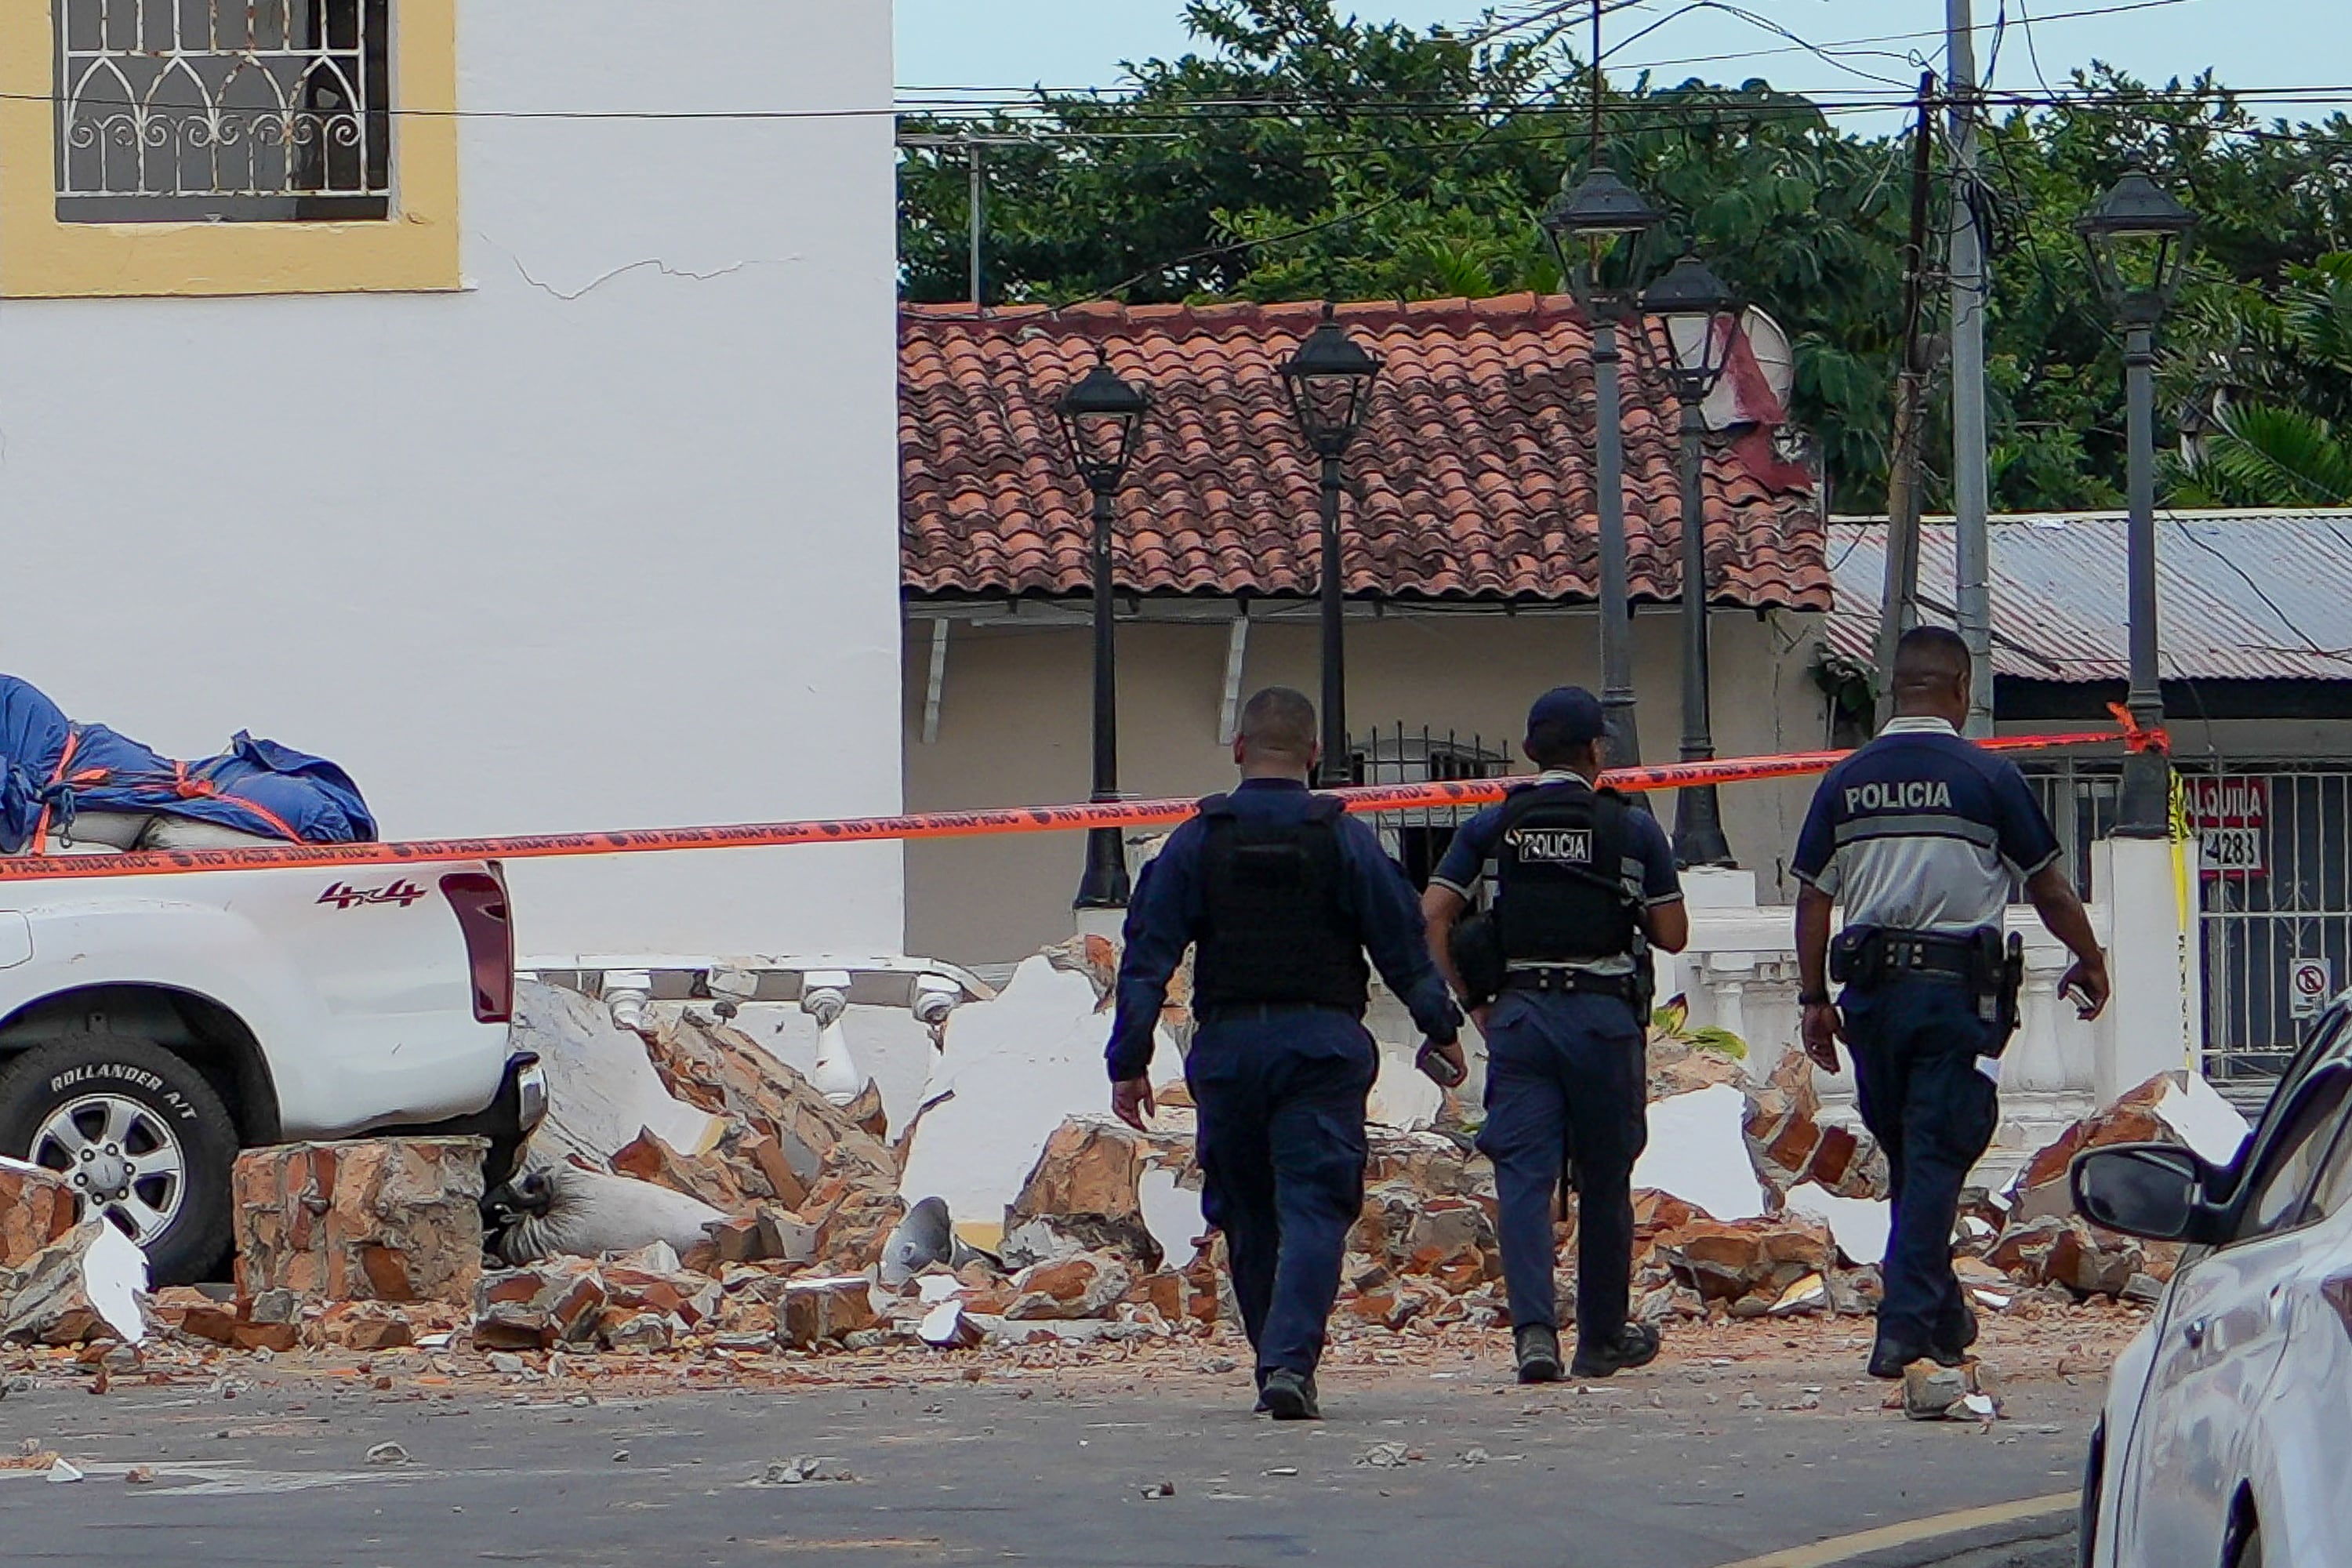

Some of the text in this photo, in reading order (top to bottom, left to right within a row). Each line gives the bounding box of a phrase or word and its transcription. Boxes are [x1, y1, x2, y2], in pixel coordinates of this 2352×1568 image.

[1845, 782, 1952, 814] POLICIA
[2184, 786, 2263, 816] ALQUILA
[1524, 833, 1586, 859] POLICIA
[315, 880, 428, 910] 4x4
[51, 1064, 198, 1119] ROLLANDER A/T
